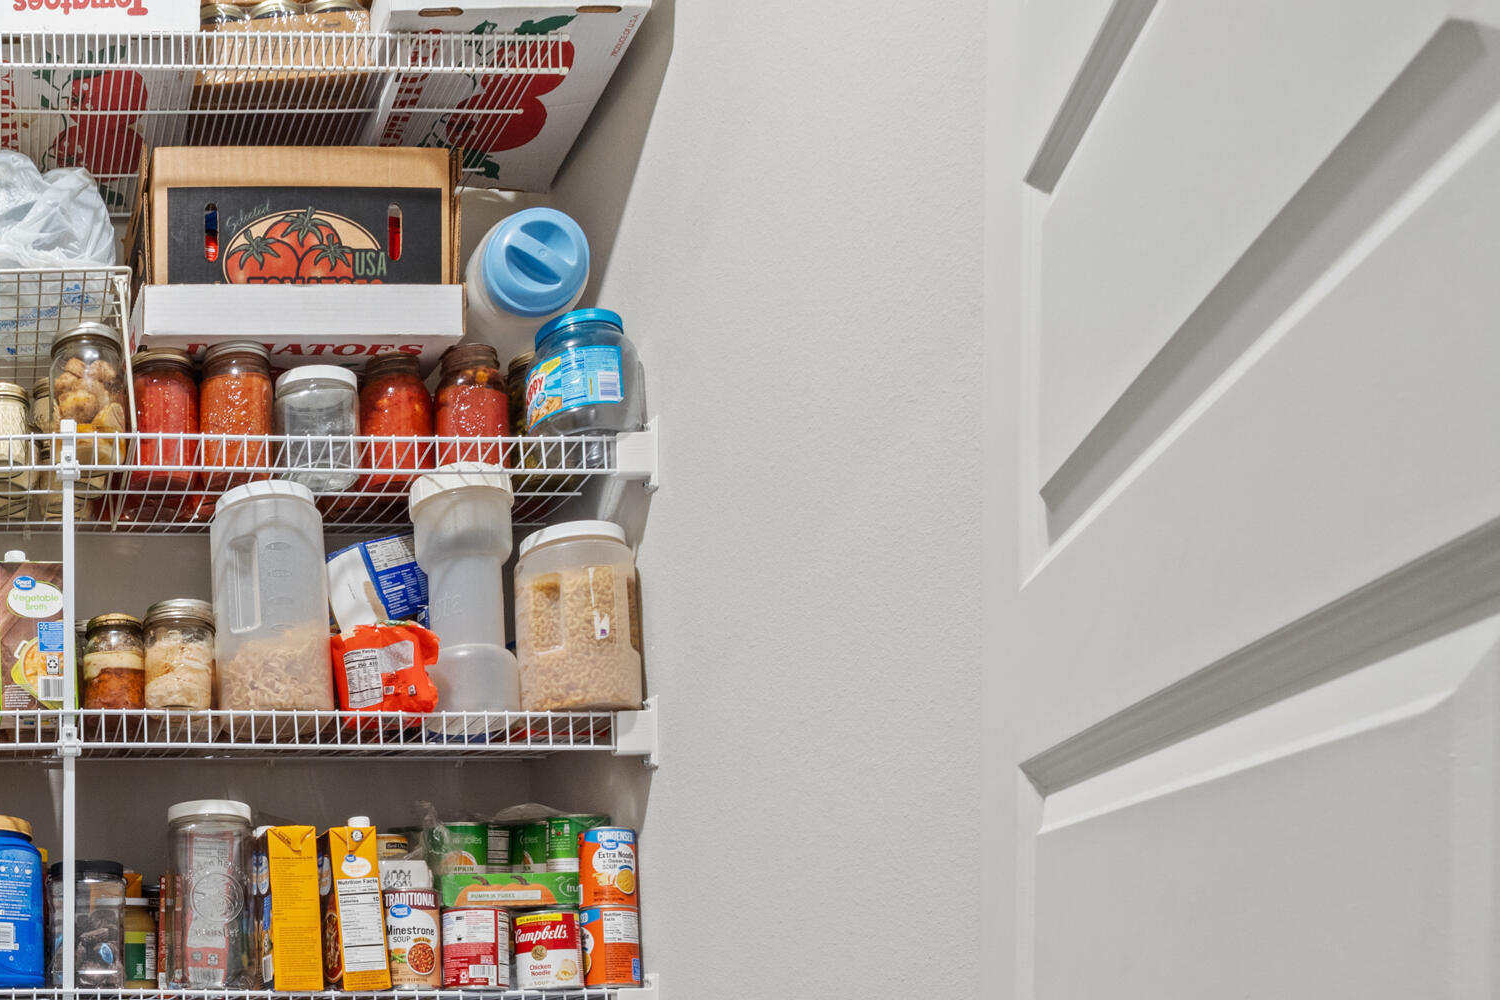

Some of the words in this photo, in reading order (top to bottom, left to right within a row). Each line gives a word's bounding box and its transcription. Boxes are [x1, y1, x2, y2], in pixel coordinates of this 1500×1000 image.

[354, 250, 387, 277] USA
[186, 343, 424, 357] TATOES
[12, 593, 59, 603] Vegetable
[25, 603, 47, 611] Broth
[597, 851, 616, 860] Extra
[384, 891, 436, 907] TRADITIONAL
[386, 924, 435, 936] Minestrone
[514, 924, 569, 944] Campbell's
[529, 964, 552, 972] Chicken
